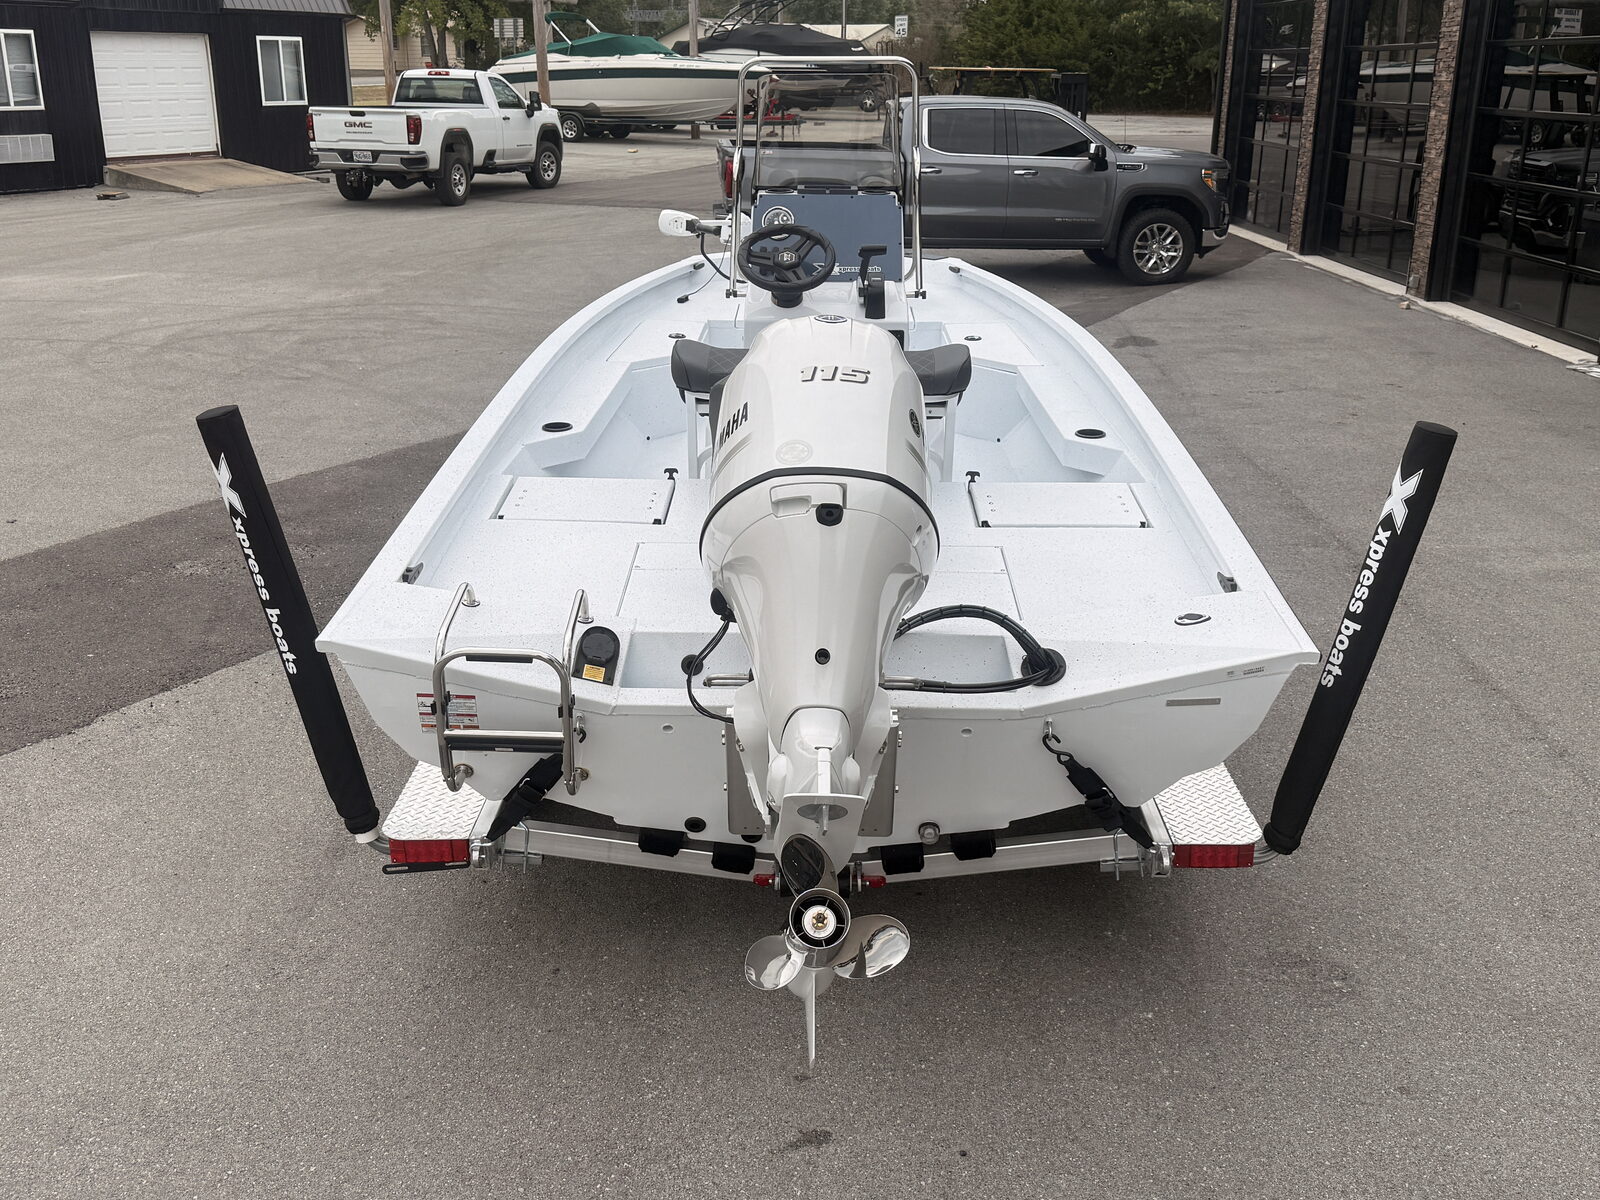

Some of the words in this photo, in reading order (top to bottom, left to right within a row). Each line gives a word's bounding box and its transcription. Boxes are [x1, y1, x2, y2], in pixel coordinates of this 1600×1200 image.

[344, 121, 373, 129] GMC
[800, 365, 871, 384] 115
[719, 401, 749, 450] MAHA
[231, 515, 270, 601] xpress
[265, 607, 298, 675] boats
[1348, 525, 1392, 615] xpress
[1321, 618, 1362, 689] boats
